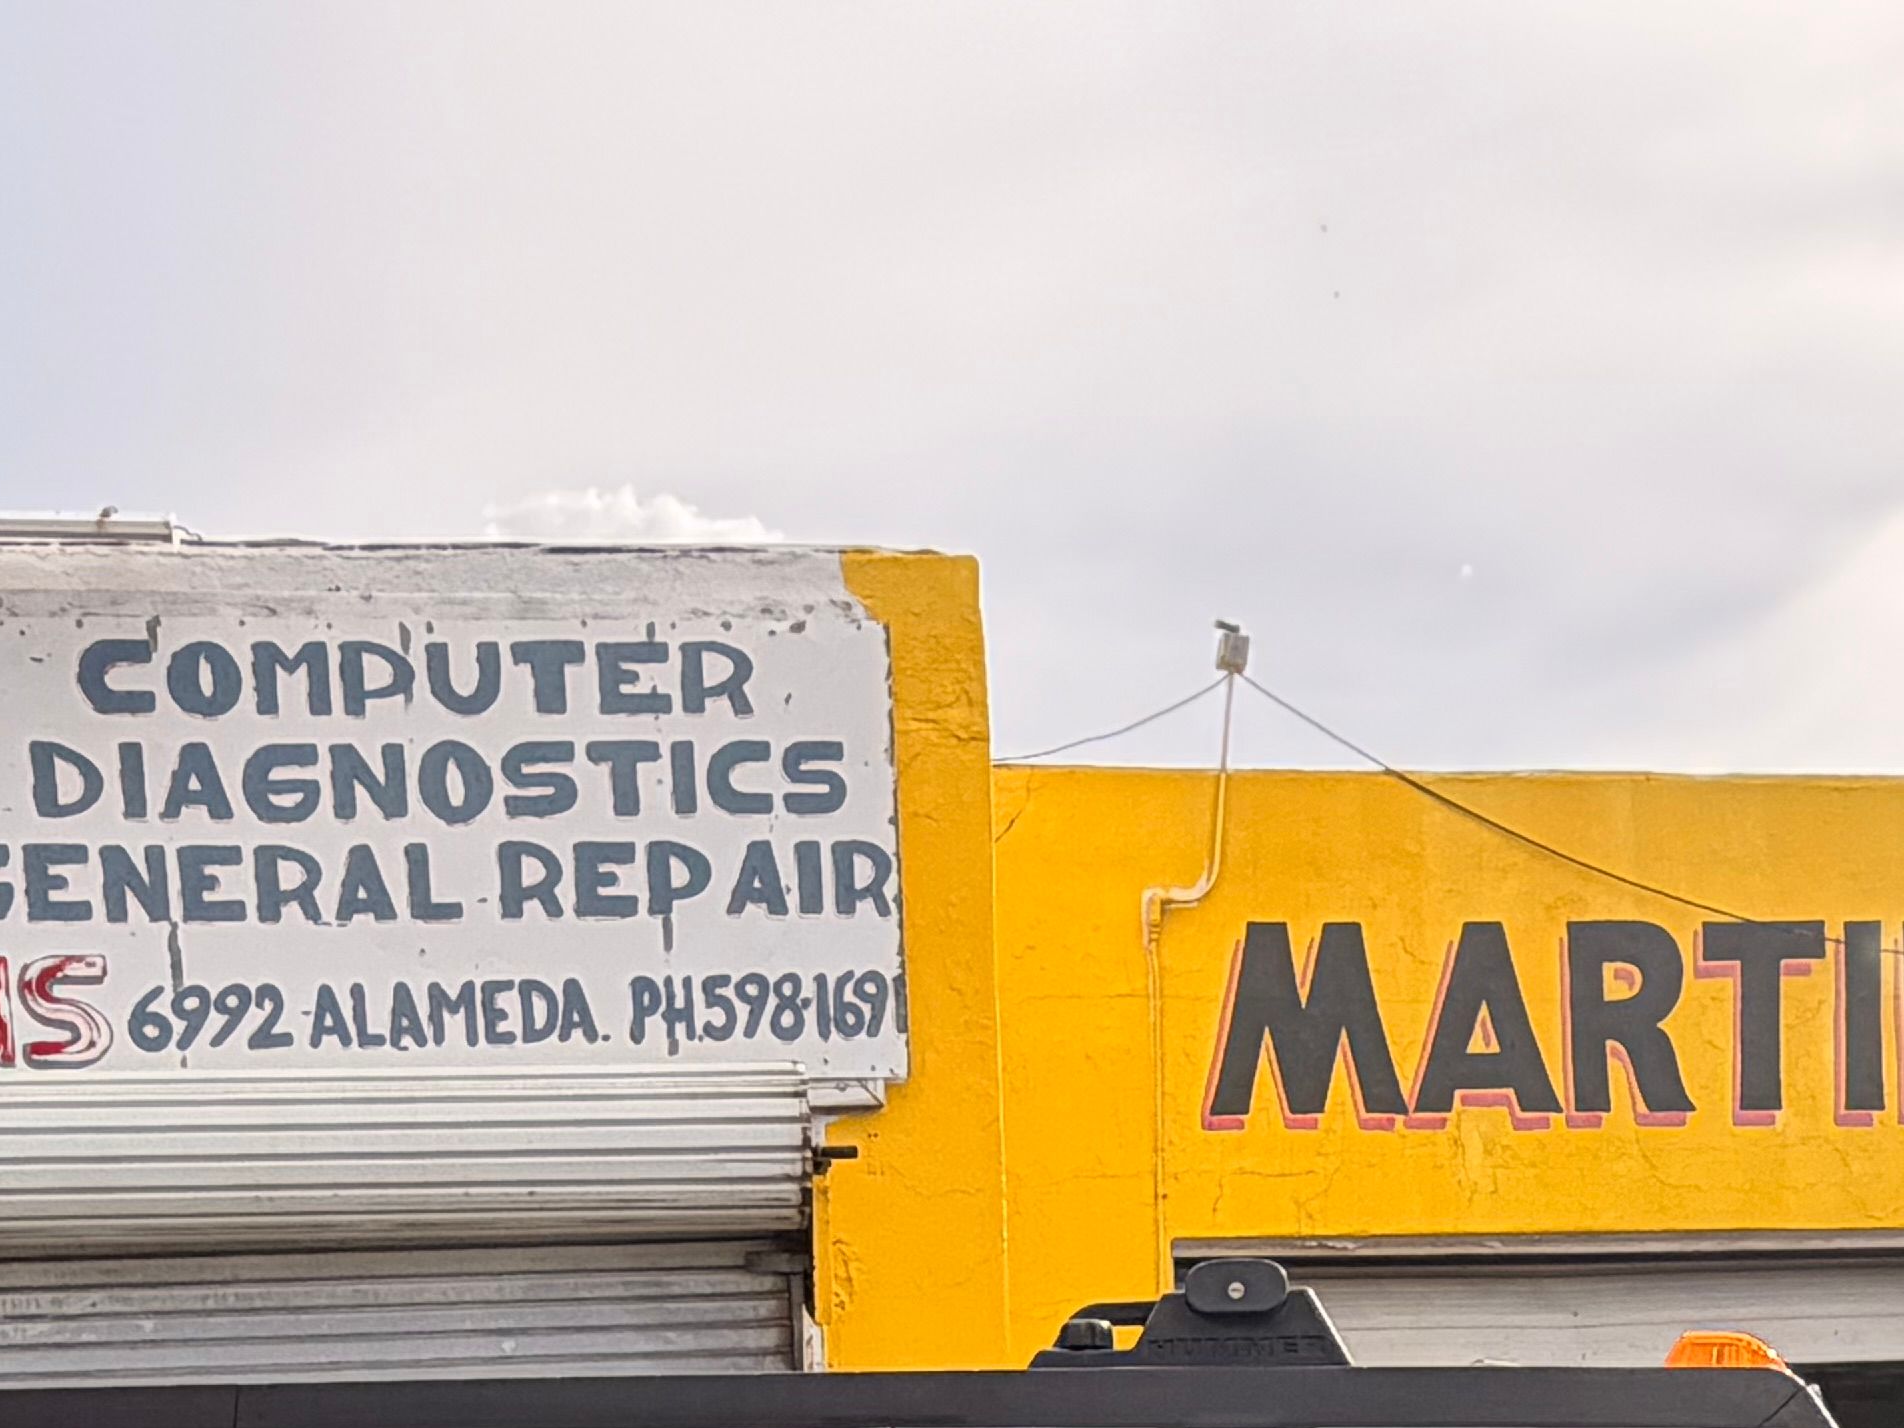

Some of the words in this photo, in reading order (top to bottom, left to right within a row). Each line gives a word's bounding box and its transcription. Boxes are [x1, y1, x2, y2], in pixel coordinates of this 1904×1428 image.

[78, 638, 754, 719] COMPUTER
[29, 739, 847, 824] DIAGNOSTICS
[496, 837, 894, 920] REPAIR
[128, 982, 294, 1052] 6992
